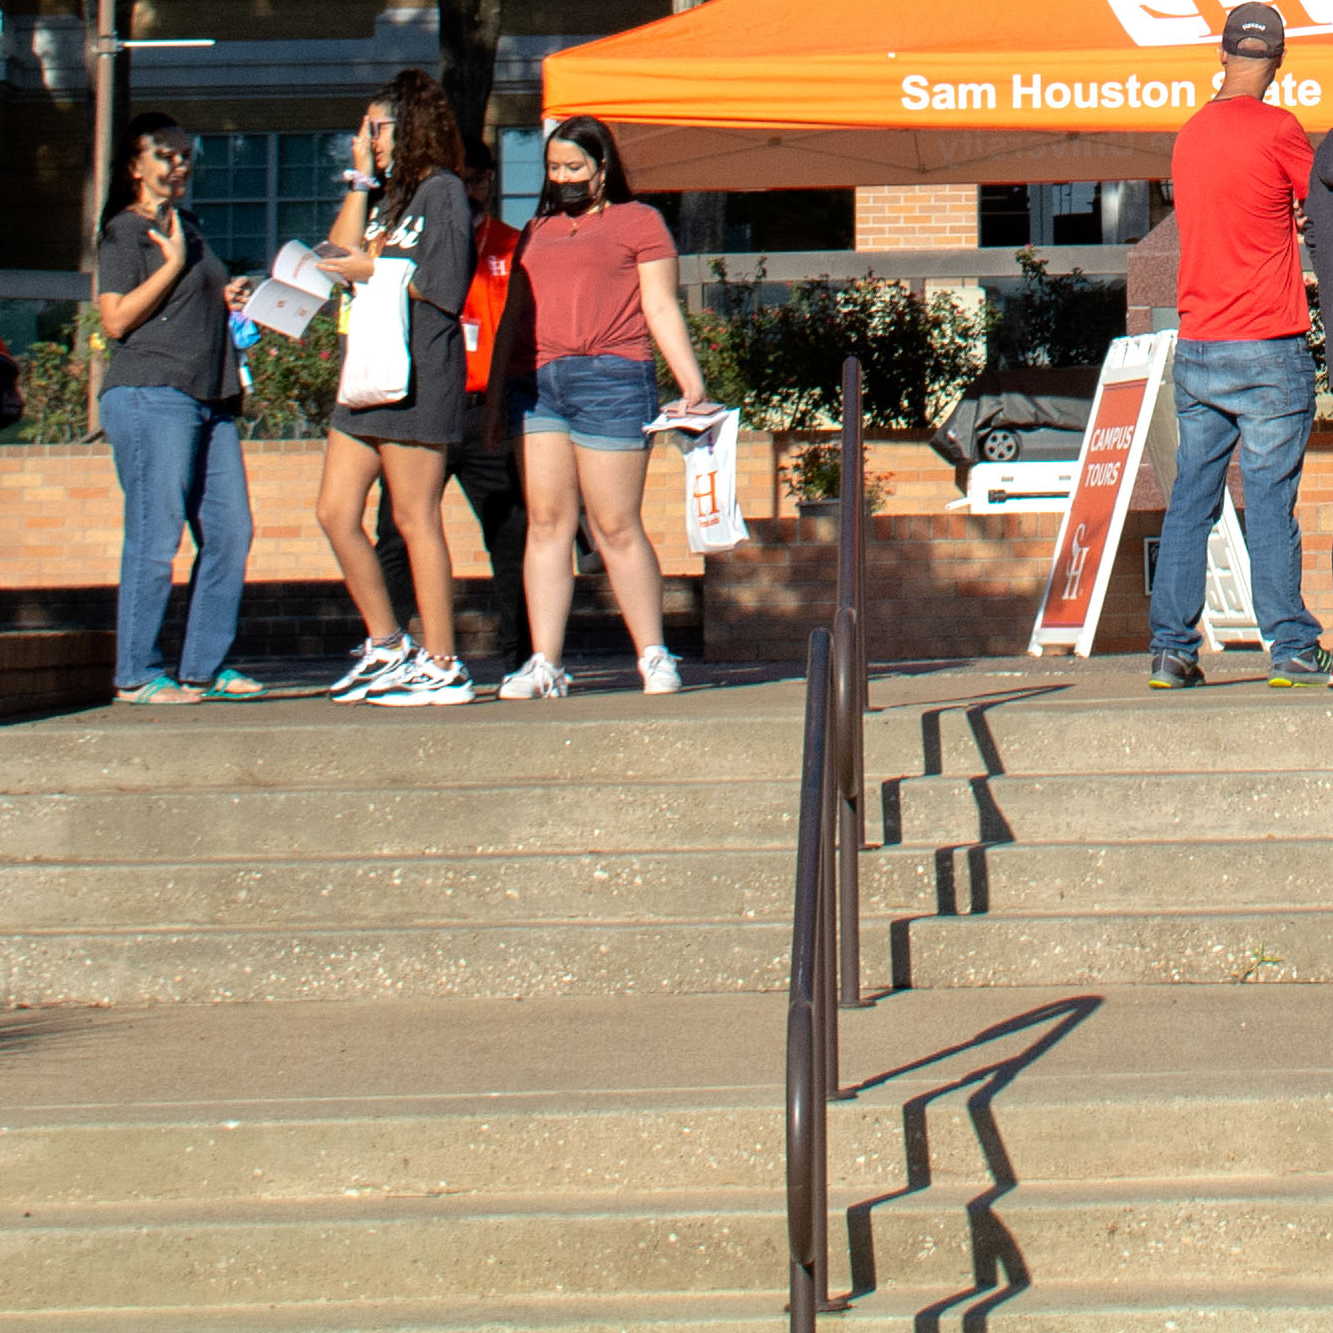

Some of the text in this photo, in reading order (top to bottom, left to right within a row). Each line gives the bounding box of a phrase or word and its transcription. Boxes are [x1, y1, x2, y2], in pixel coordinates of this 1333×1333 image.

[902, 74, 995, 109] Sam
[1012, 73, 1196, 109] Houston
[1212, 72, 1322, 107] ate
[1090, 425, 1134, 453] CAMPUS
[1085, 461, 1122, 487] TOURS
